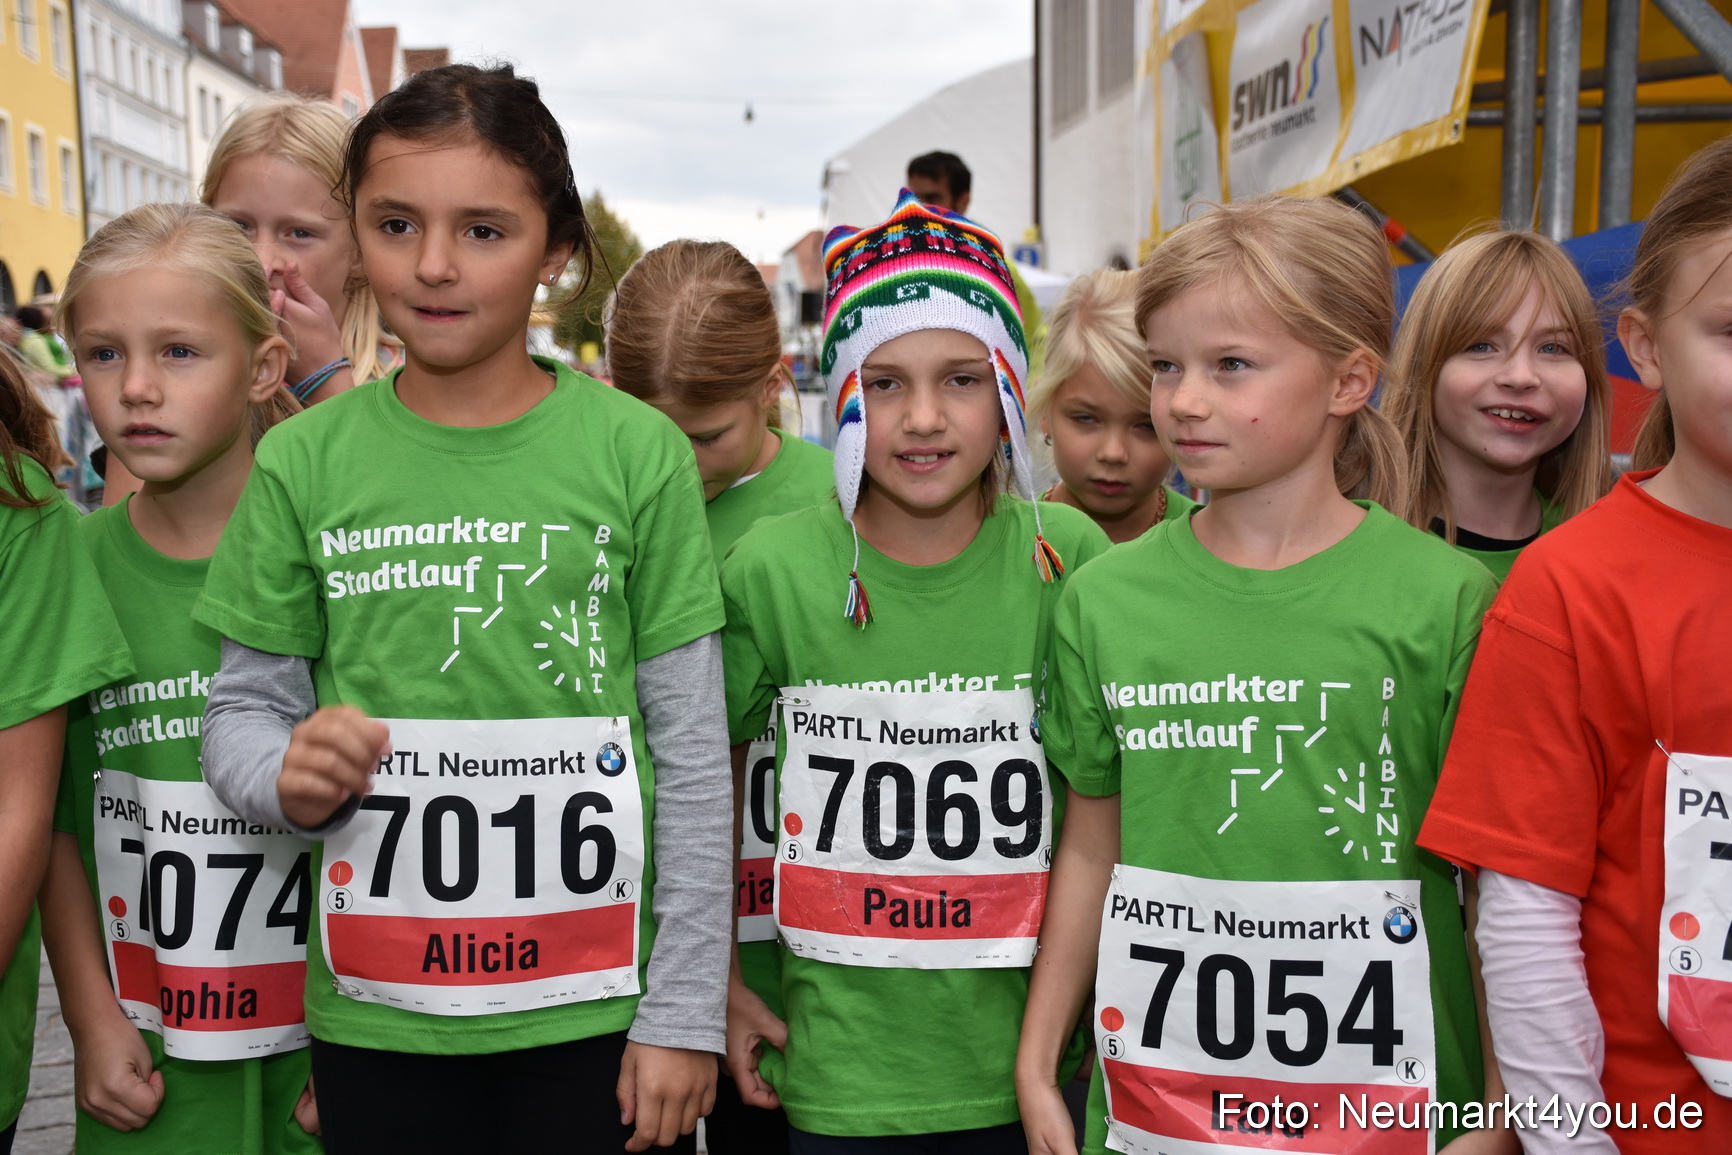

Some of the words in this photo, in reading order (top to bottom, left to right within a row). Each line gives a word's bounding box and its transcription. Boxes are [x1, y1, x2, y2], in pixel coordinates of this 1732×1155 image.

[320, 515, 526, 557] Neumarkter
[326, 555, 483, 599] Stadtlauf
[587, 525, 611, 693] BAMBINI
[88, 670, 219, 714] eumark
[1101, 673, 1304, 710] Neumarkter
[792, 711, 872, 742] PARTL
[879, 719, 1019, 745] Neumarkt
[370, 750, 430, 777] RTL
[438, 750, 586, 777] Neumarkt
[808, 753, 1043, 862] 7069
[358, 791, 617, 903] 7016
[788, 843, 797, 861] 5
[120, 838, 313, 951] 7074
[335, 891, 345, 910] 5
[615, 881, 627, 899] K
[864, 887, 972, 929] Paula
[116, 922, 125, 938] 5
[1110, 893, 1205, 933] PARTL
[1213, 909, 1371, 940] Neumarkt
[421, 931, 540, 975] Alicia
[1679, 950, 1692, 971] 5
[160, 981, 258, 1027] ophia
[1129, 943, 1404, 1067] 7054
[1108, 1038, 1118, 1056] 5
[1404, 1061, 1417, 1080] K
